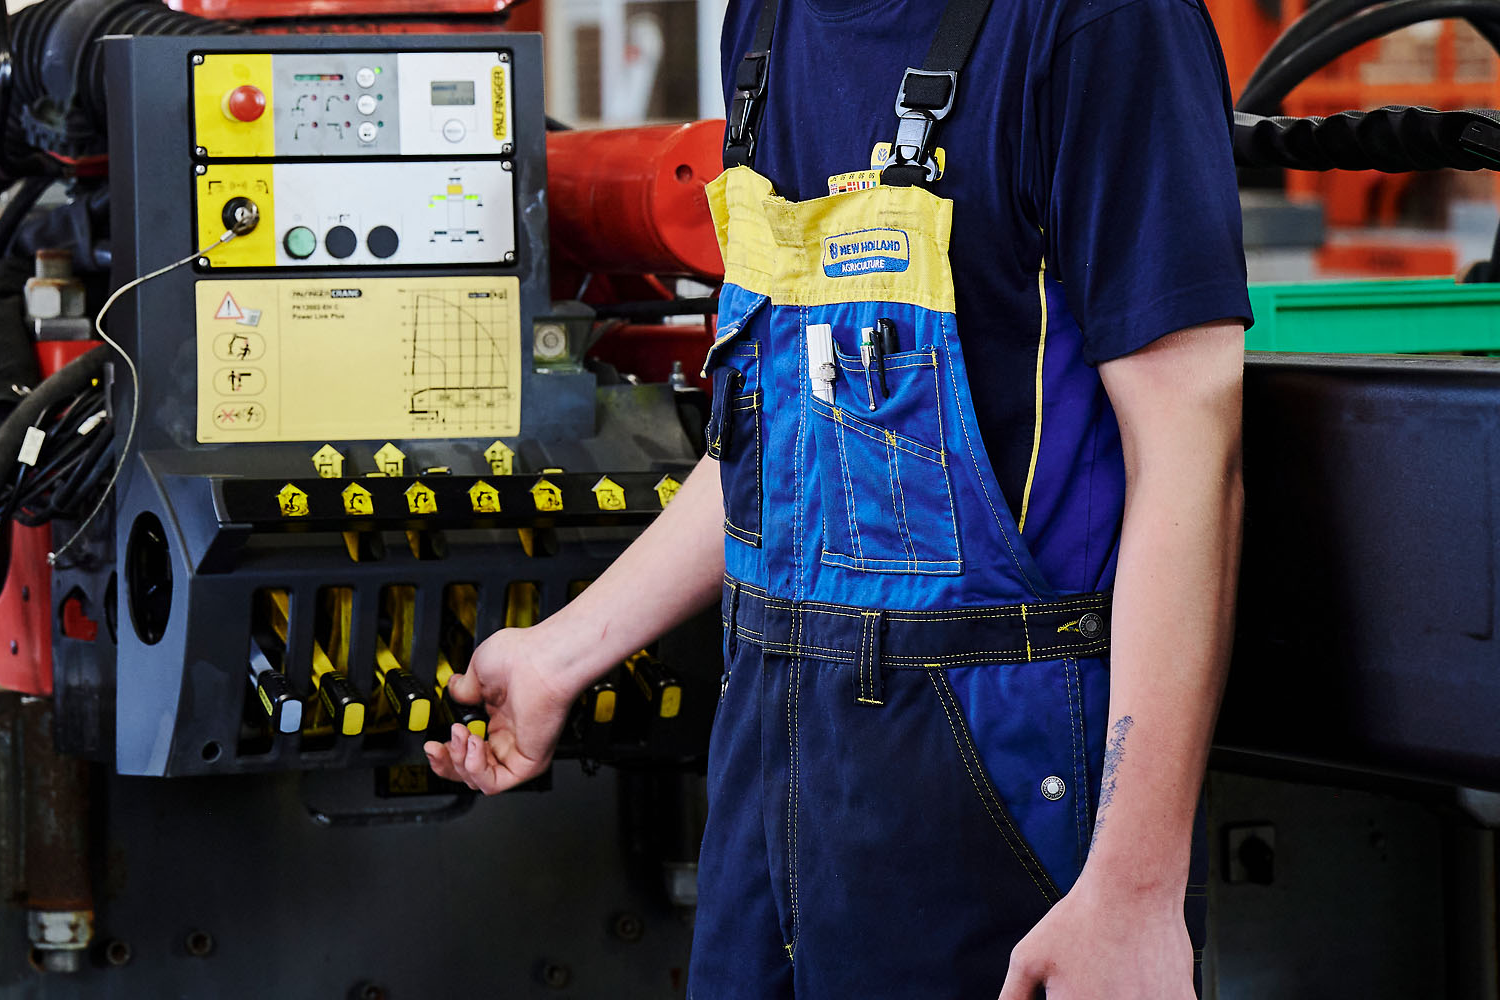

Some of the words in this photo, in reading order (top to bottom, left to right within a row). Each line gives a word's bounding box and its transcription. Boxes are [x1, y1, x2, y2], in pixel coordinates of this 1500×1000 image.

[493, 71, 505, 136] PALFINGER
[840, 242, 859, 256] NEW
[861, 240, 900, 252] HOLLAND
[841, 259, 885, 272] AGRICULTURE
